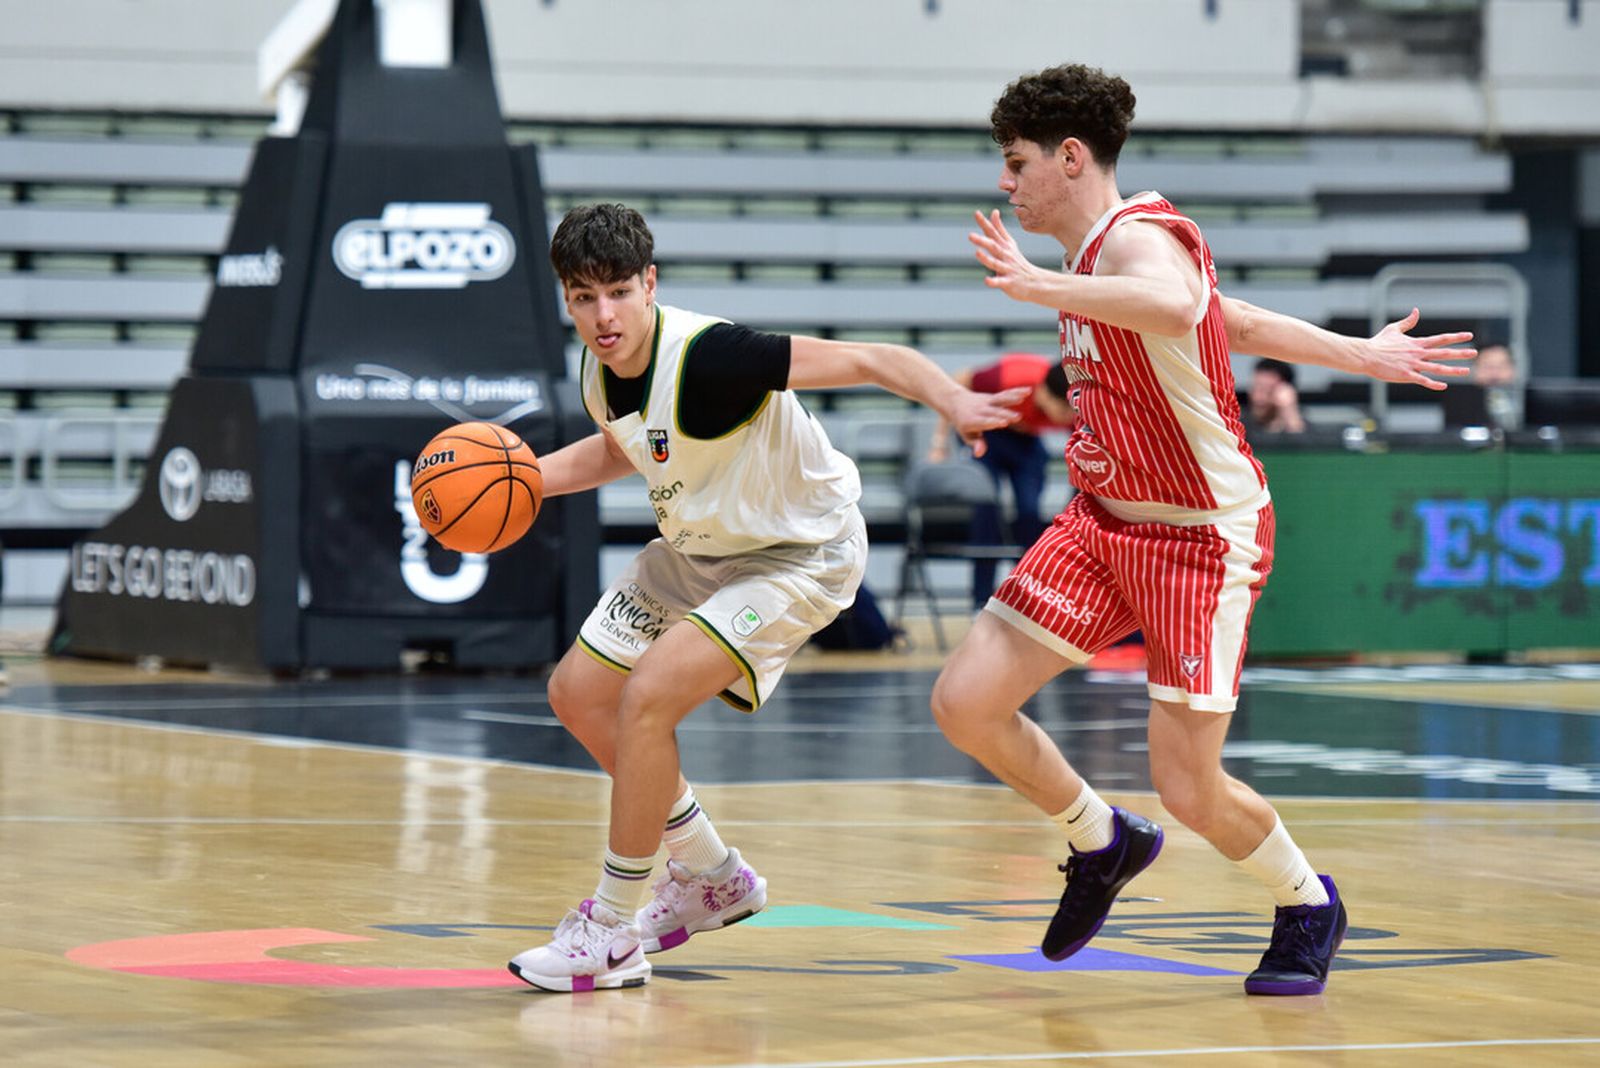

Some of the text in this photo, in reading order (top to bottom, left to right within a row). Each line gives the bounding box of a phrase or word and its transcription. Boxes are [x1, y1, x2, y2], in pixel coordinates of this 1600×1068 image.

[1413, 497, 1600, 590] EST
[125, 546, 162, 599] GO
[600, 617, 641, 652] DENTAL
